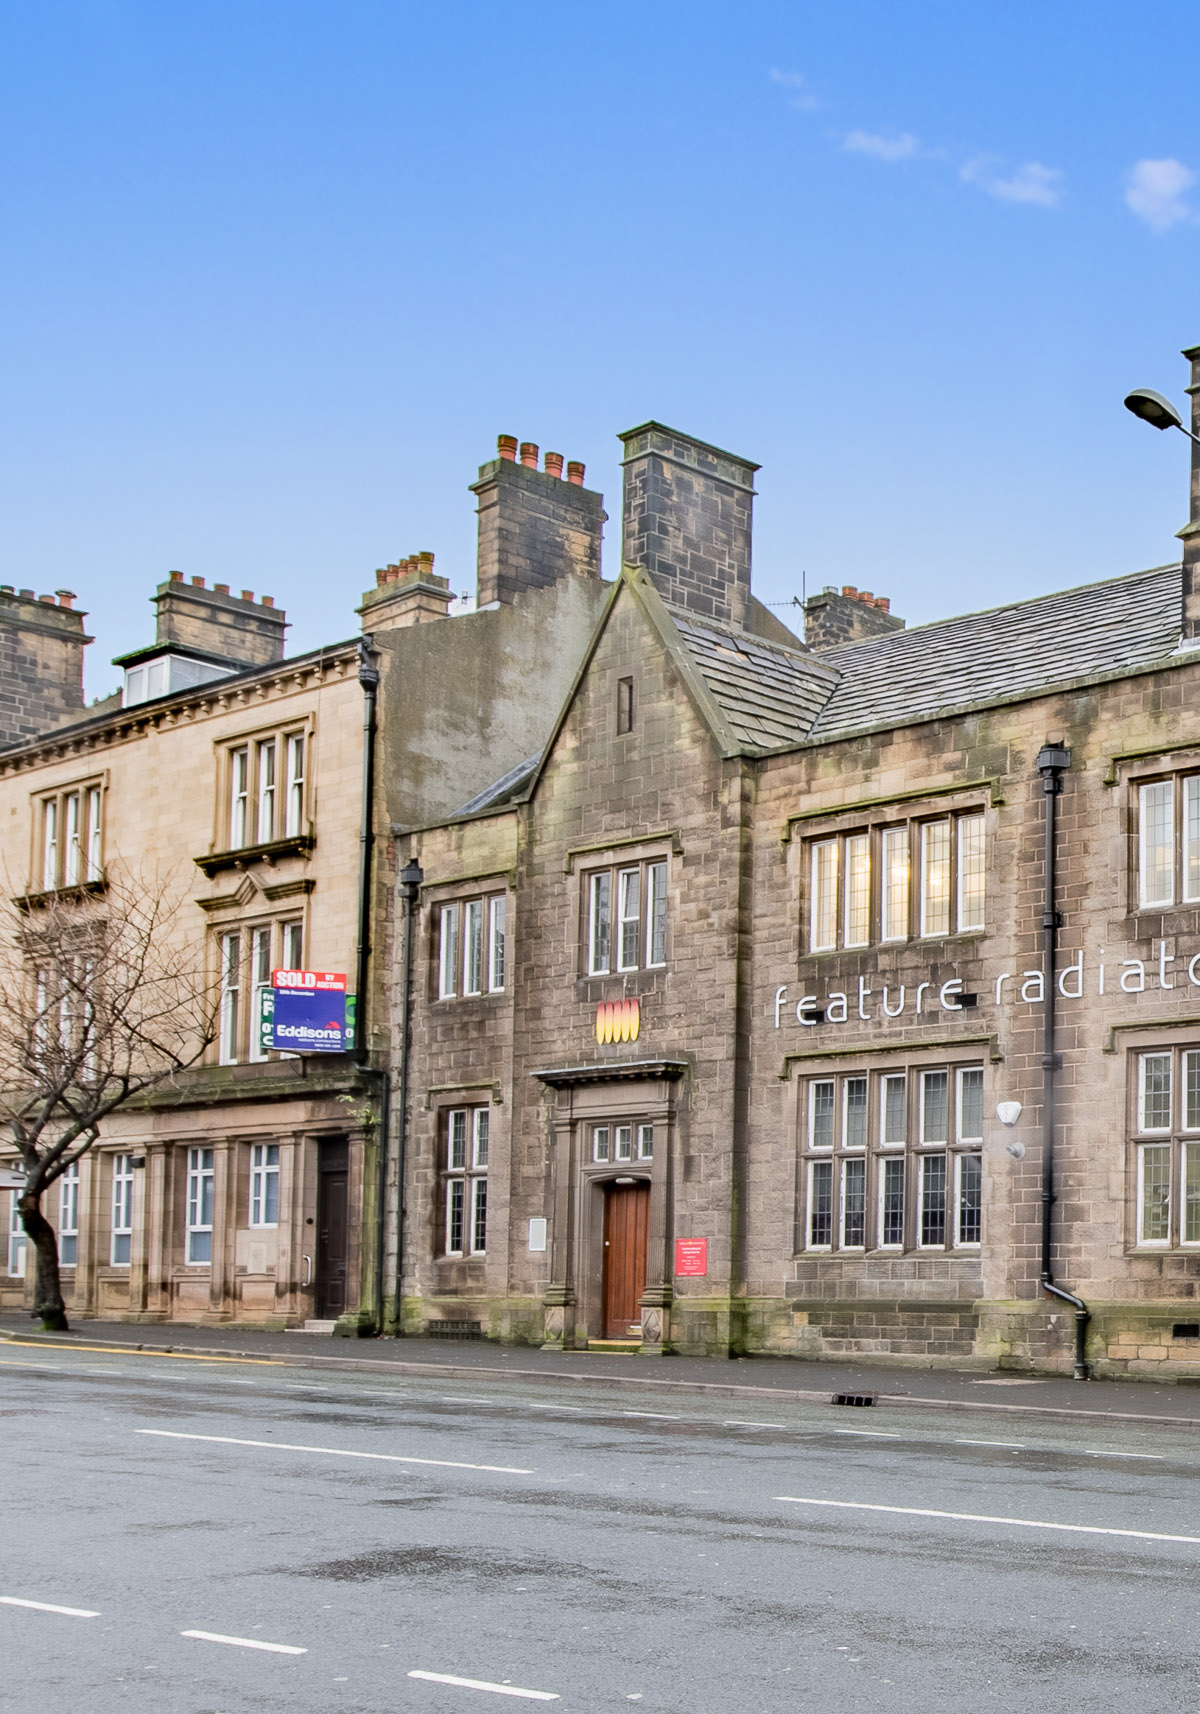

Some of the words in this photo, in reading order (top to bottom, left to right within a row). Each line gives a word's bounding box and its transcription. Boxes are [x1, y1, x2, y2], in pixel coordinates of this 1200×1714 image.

[276, 971, 316, 988] SOLD
[774, 975, 963, 1029] feature
[277, 1025, 341, 1039] Eddisons
